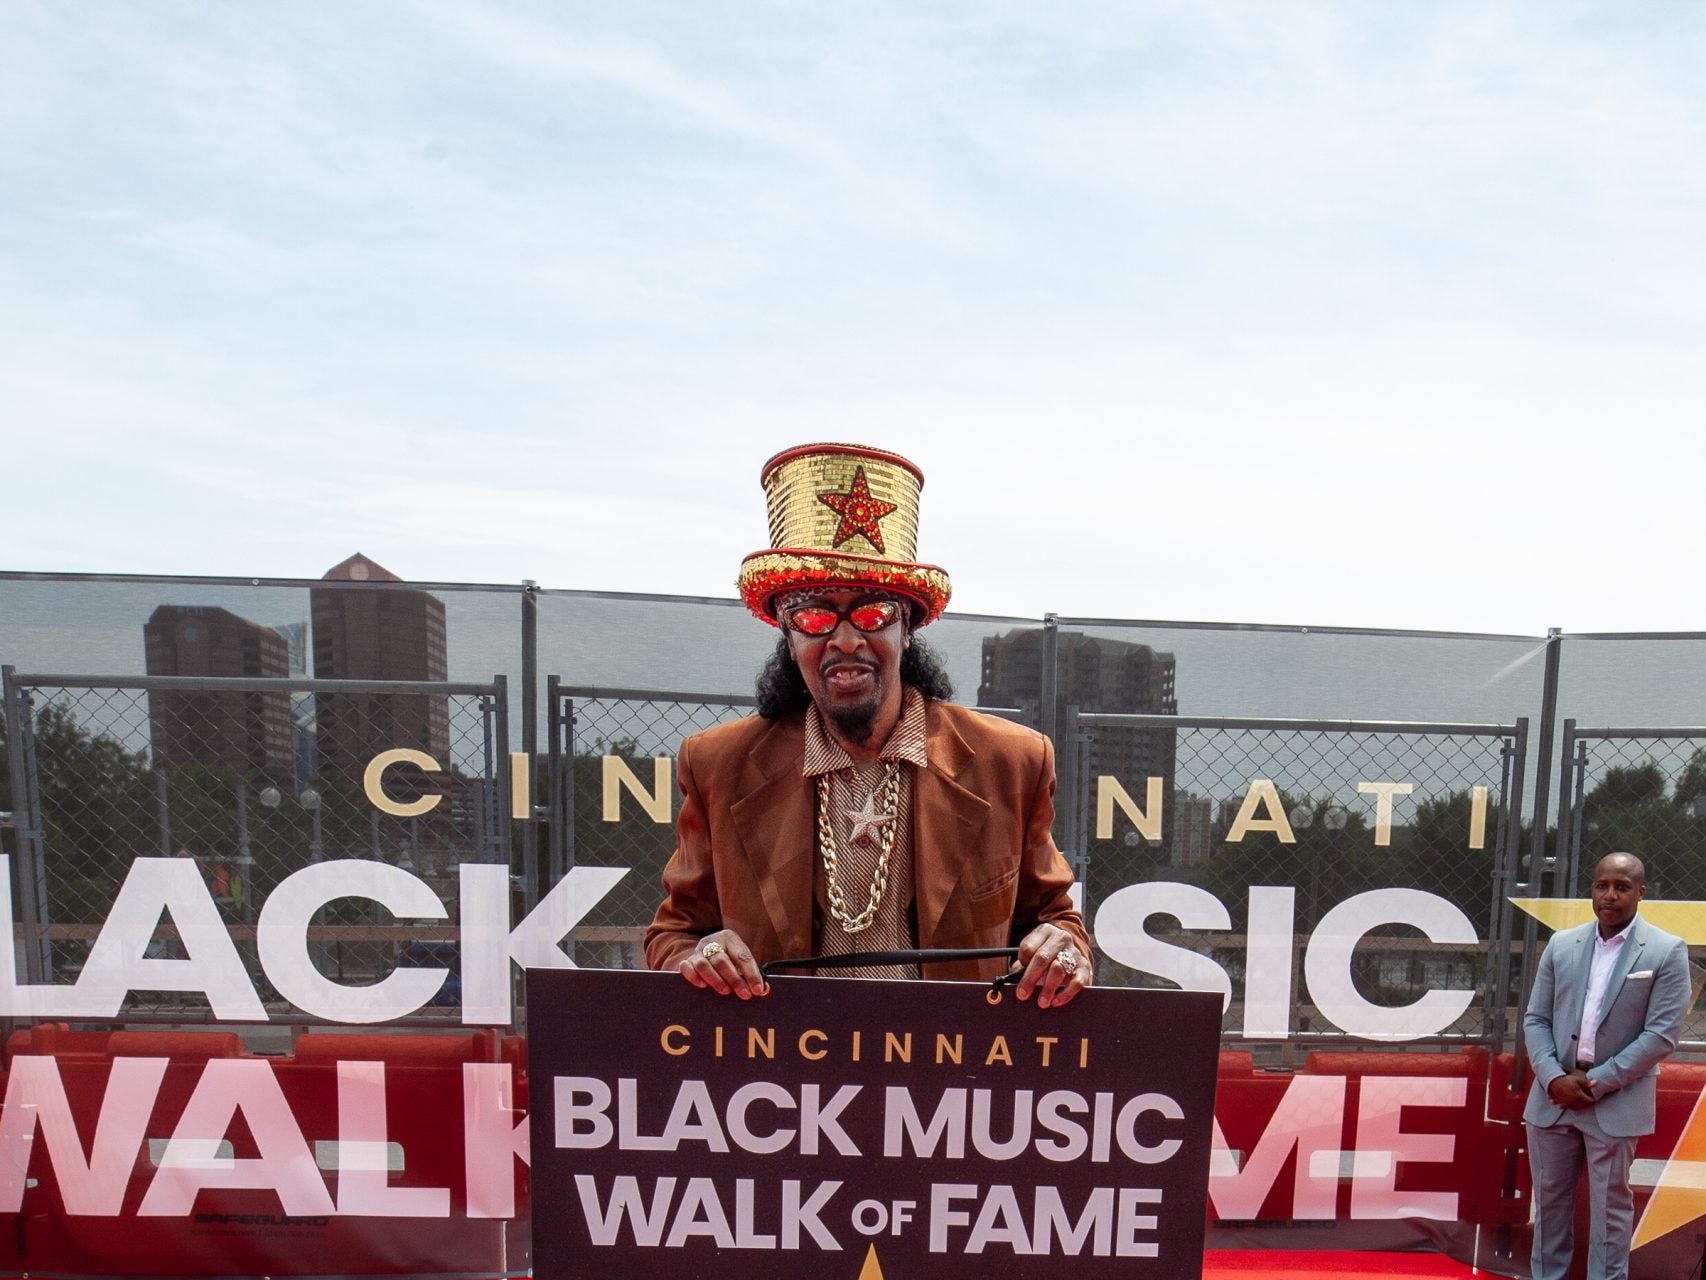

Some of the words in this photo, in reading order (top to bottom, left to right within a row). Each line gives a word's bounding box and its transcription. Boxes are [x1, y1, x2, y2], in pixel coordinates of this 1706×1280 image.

[363, 748, 1488, 849] CINNATI
[0, 853, 631, 1024] LACK
[660, 1024, 1090, 1068] CINCINNATI
[553, 1076, 863, 1157] BLACK
[883, 1086, 1186, 1164] MUSIC
[574, 1174, 844, 1252] WALK
[851, 1199, 917, 1236] OF
[929, 1183, 1164, 1258] FAME
